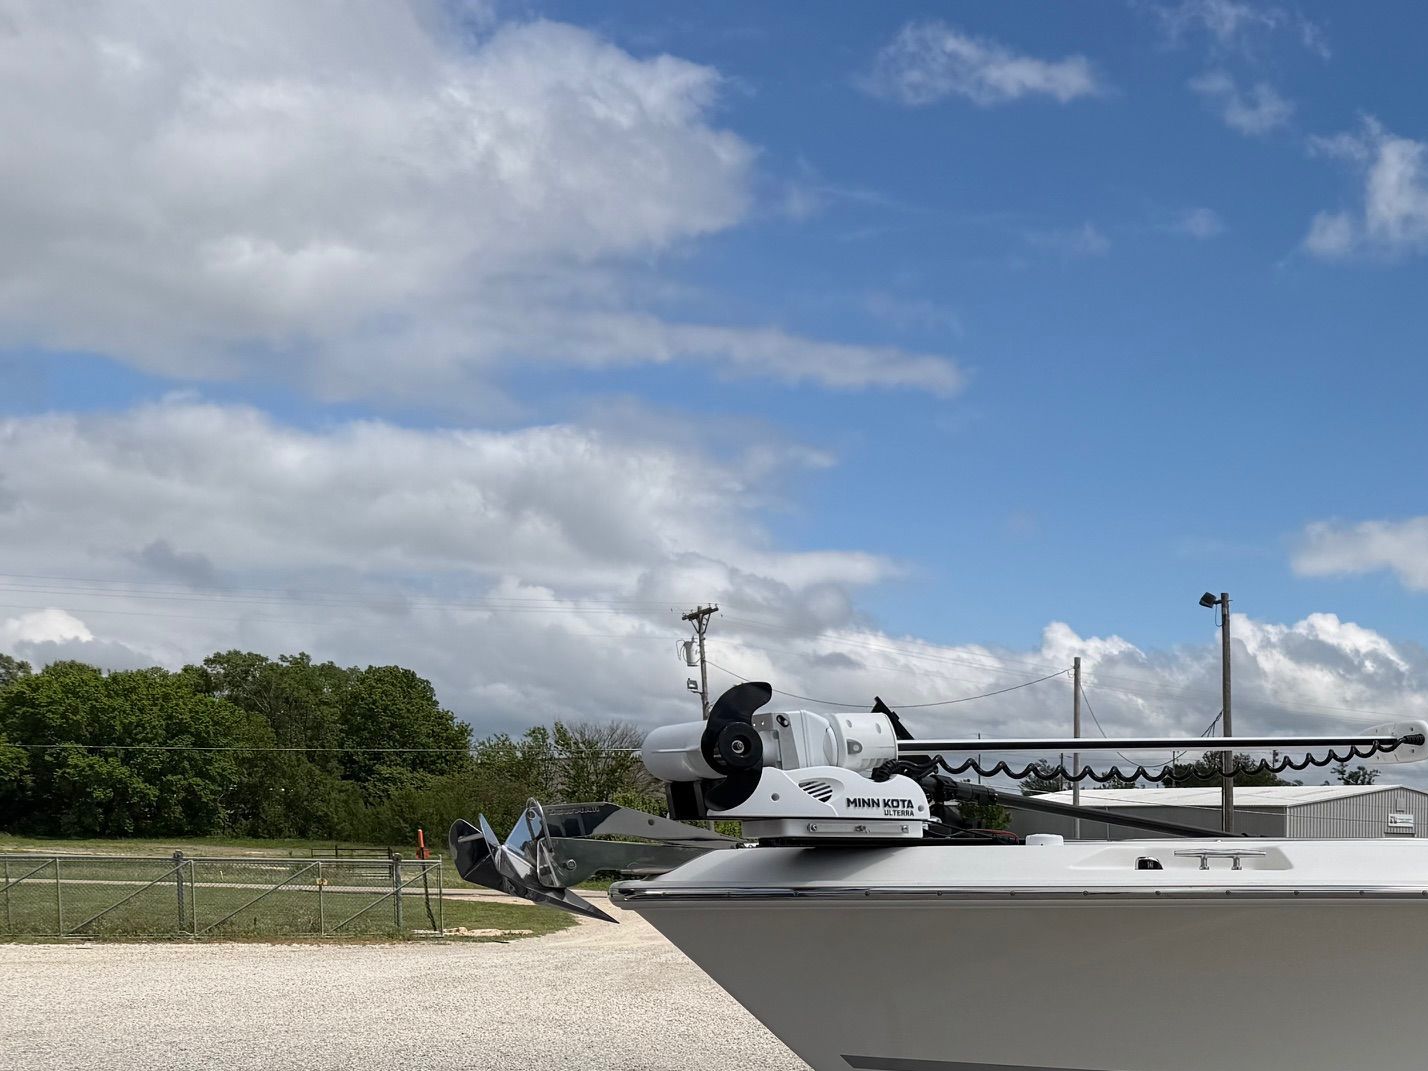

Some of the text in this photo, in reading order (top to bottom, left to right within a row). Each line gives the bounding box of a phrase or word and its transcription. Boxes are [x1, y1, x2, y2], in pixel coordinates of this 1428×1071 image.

[846, 797, 915, 809] MINN KOTA
[883, 809, 915, 817] ULTERRA
